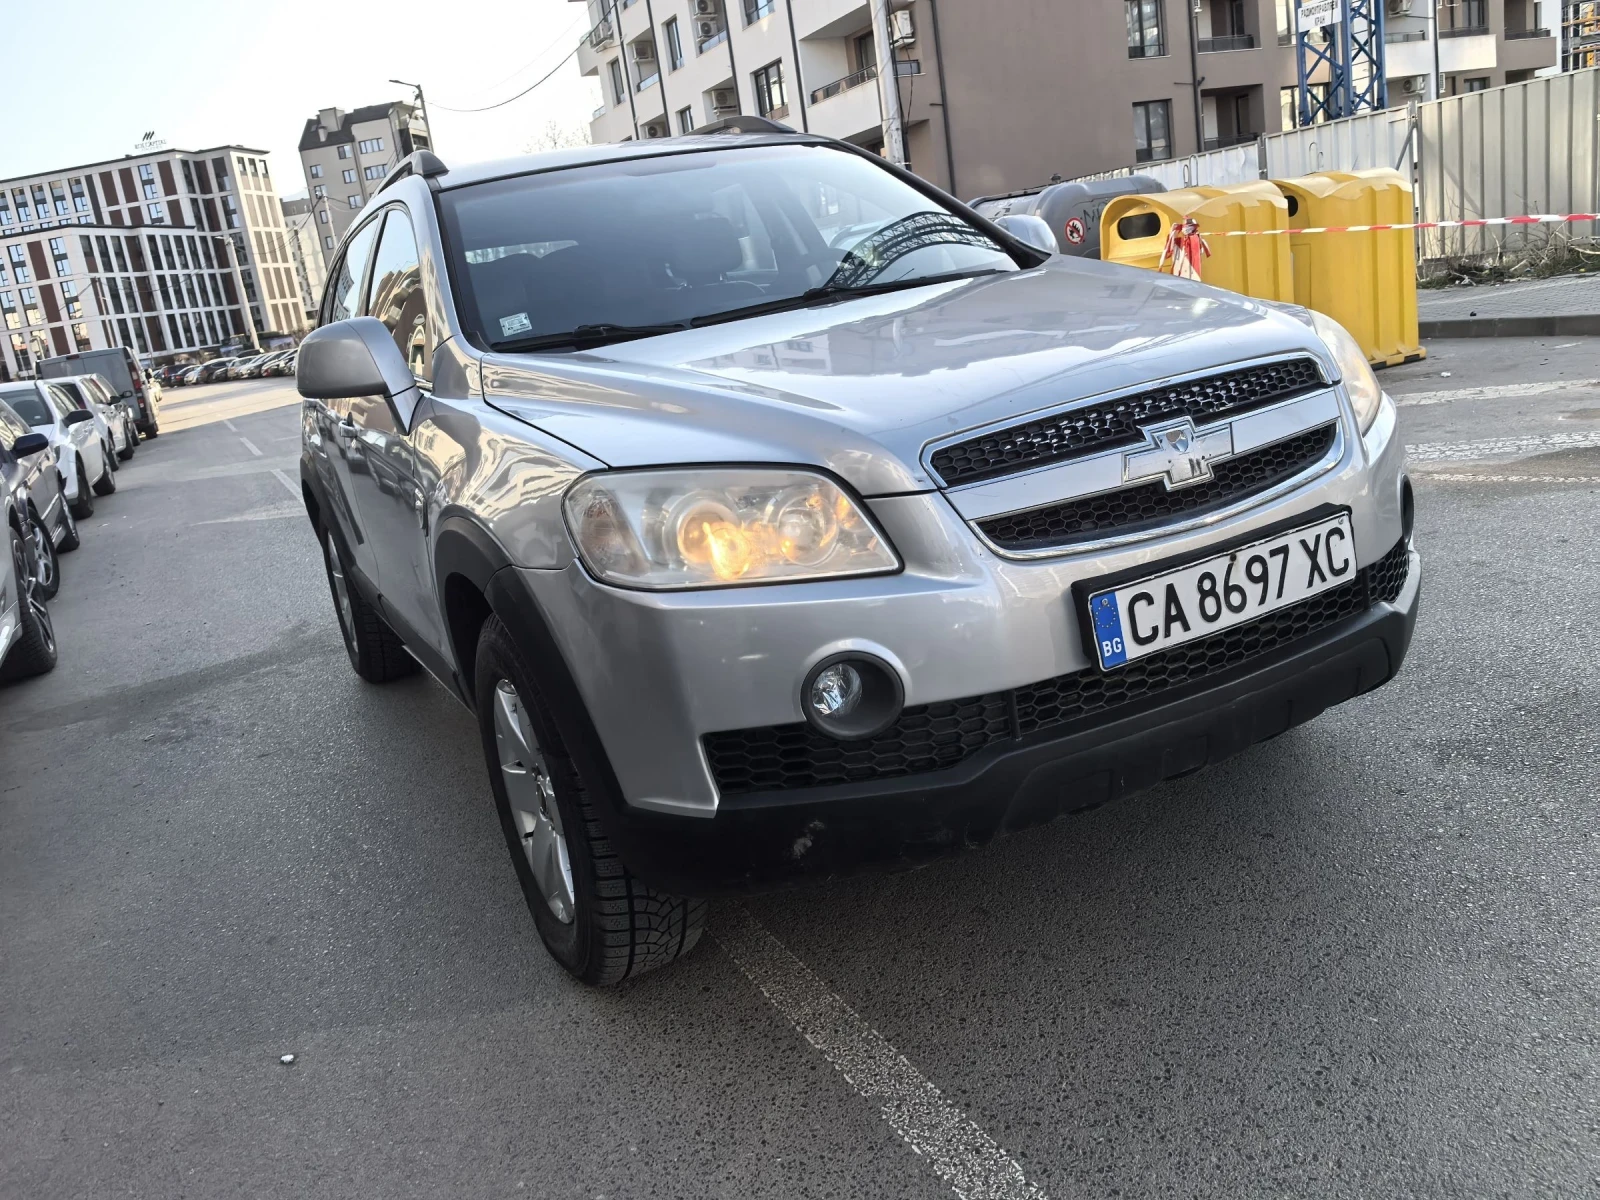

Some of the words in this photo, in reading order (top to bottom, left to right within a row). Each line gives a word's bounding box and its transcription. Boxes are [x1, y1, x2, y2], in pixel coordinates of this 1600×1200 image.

[1127, 582, 1191, 646] CA
[1197, 544, 1289, 623] 8697
[1299, 526, 1350, 589] XC
[1102, 637, 1122, 657] BG
